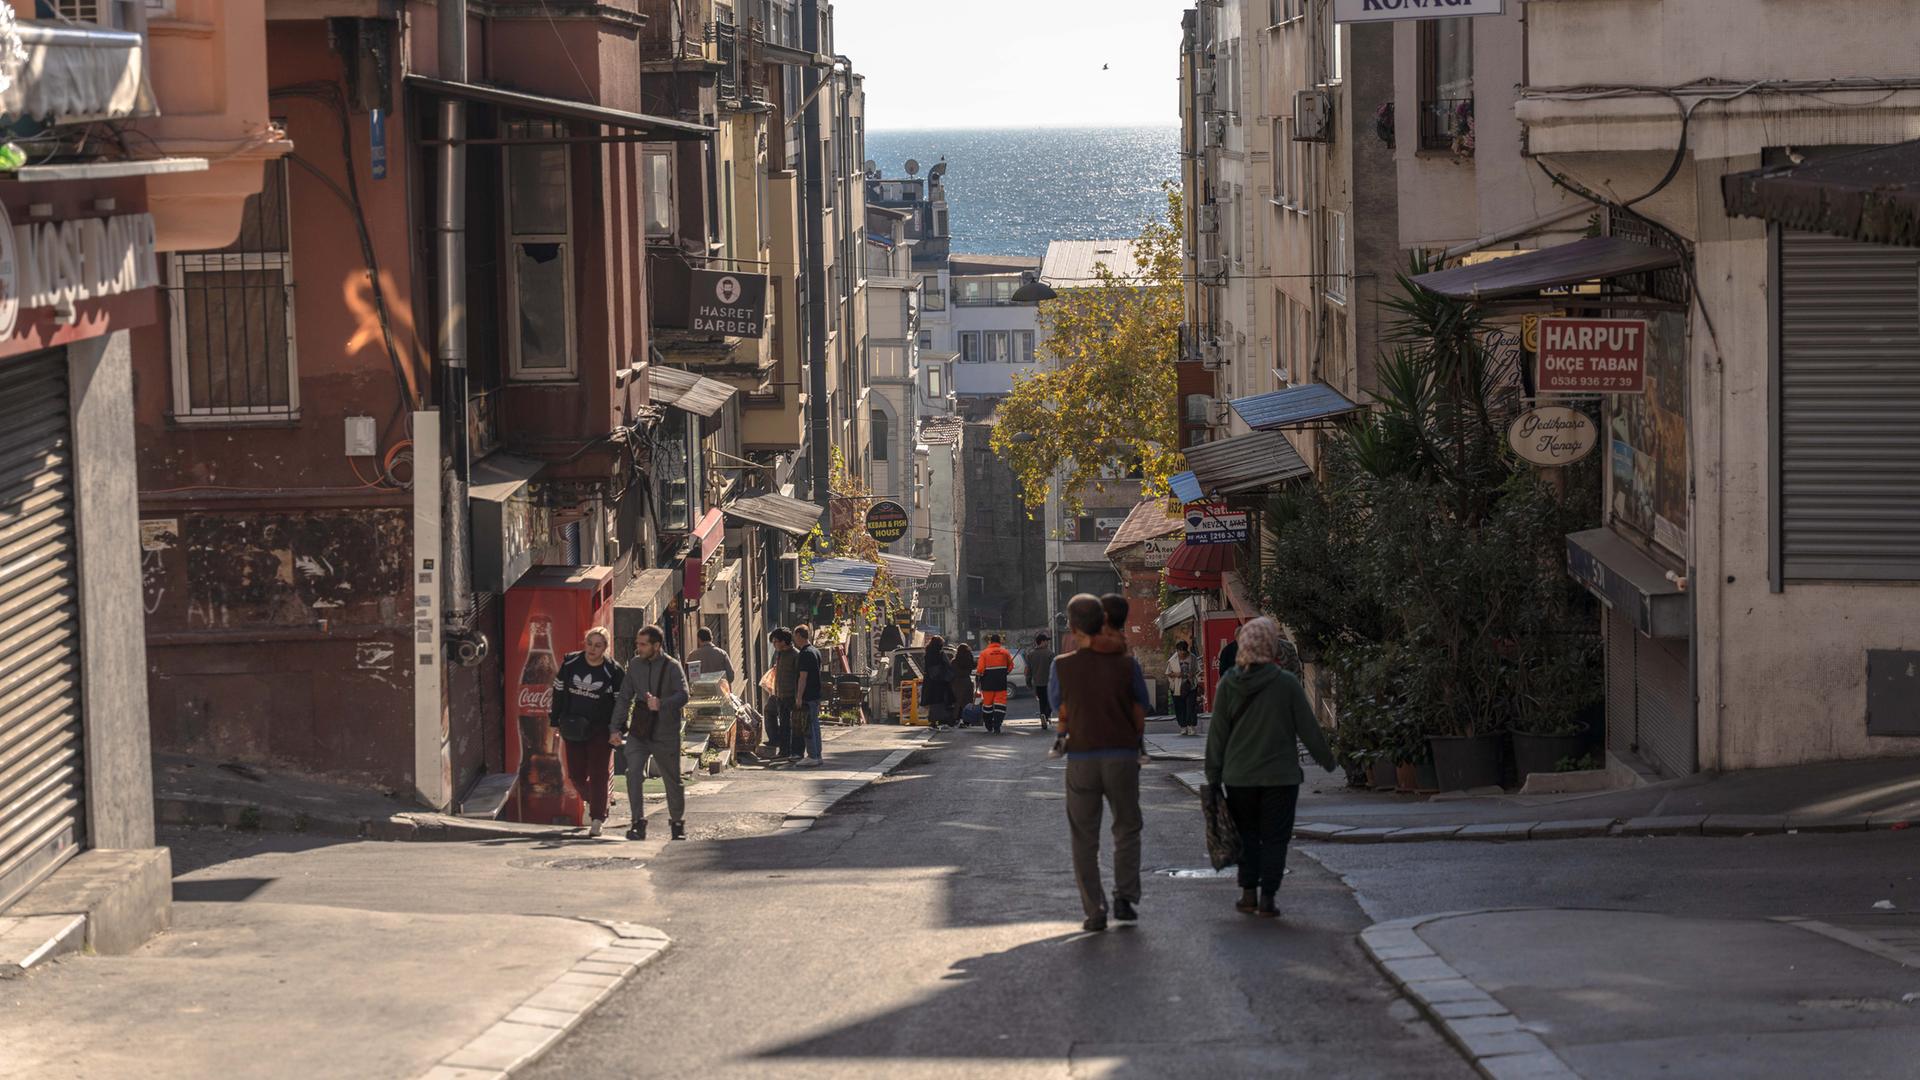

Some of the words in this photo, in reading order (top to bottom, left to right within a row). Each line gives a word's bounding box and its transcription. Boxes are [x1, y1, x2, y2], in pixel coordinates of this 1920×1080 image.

[1363, 0, 1472, 11] KONA
[700, 306, 753, 319] HASRET
[694, 318, 756, 334] BARBER
[1546, 326, 1639, 351] HARPUT
[1545, 354, 1584, 373] ÖKÇE
[1590, 358, 1637, 371] TABAN
[1551, 377, 1577, 386] 0536
[1580, 377, 1600, 386] 936
[1603, 378, 1615, 386] 27
[1619, 378, 1632, 387] 39
[1520, 415, 1584, 438] Gedikpaşa
[1536, 435, 1582, 457] Konağı
[894, 519, 907, 527] FISH
[875, 529, 900, 537] HOUSE
[568, 687, 600, 699] adidas
